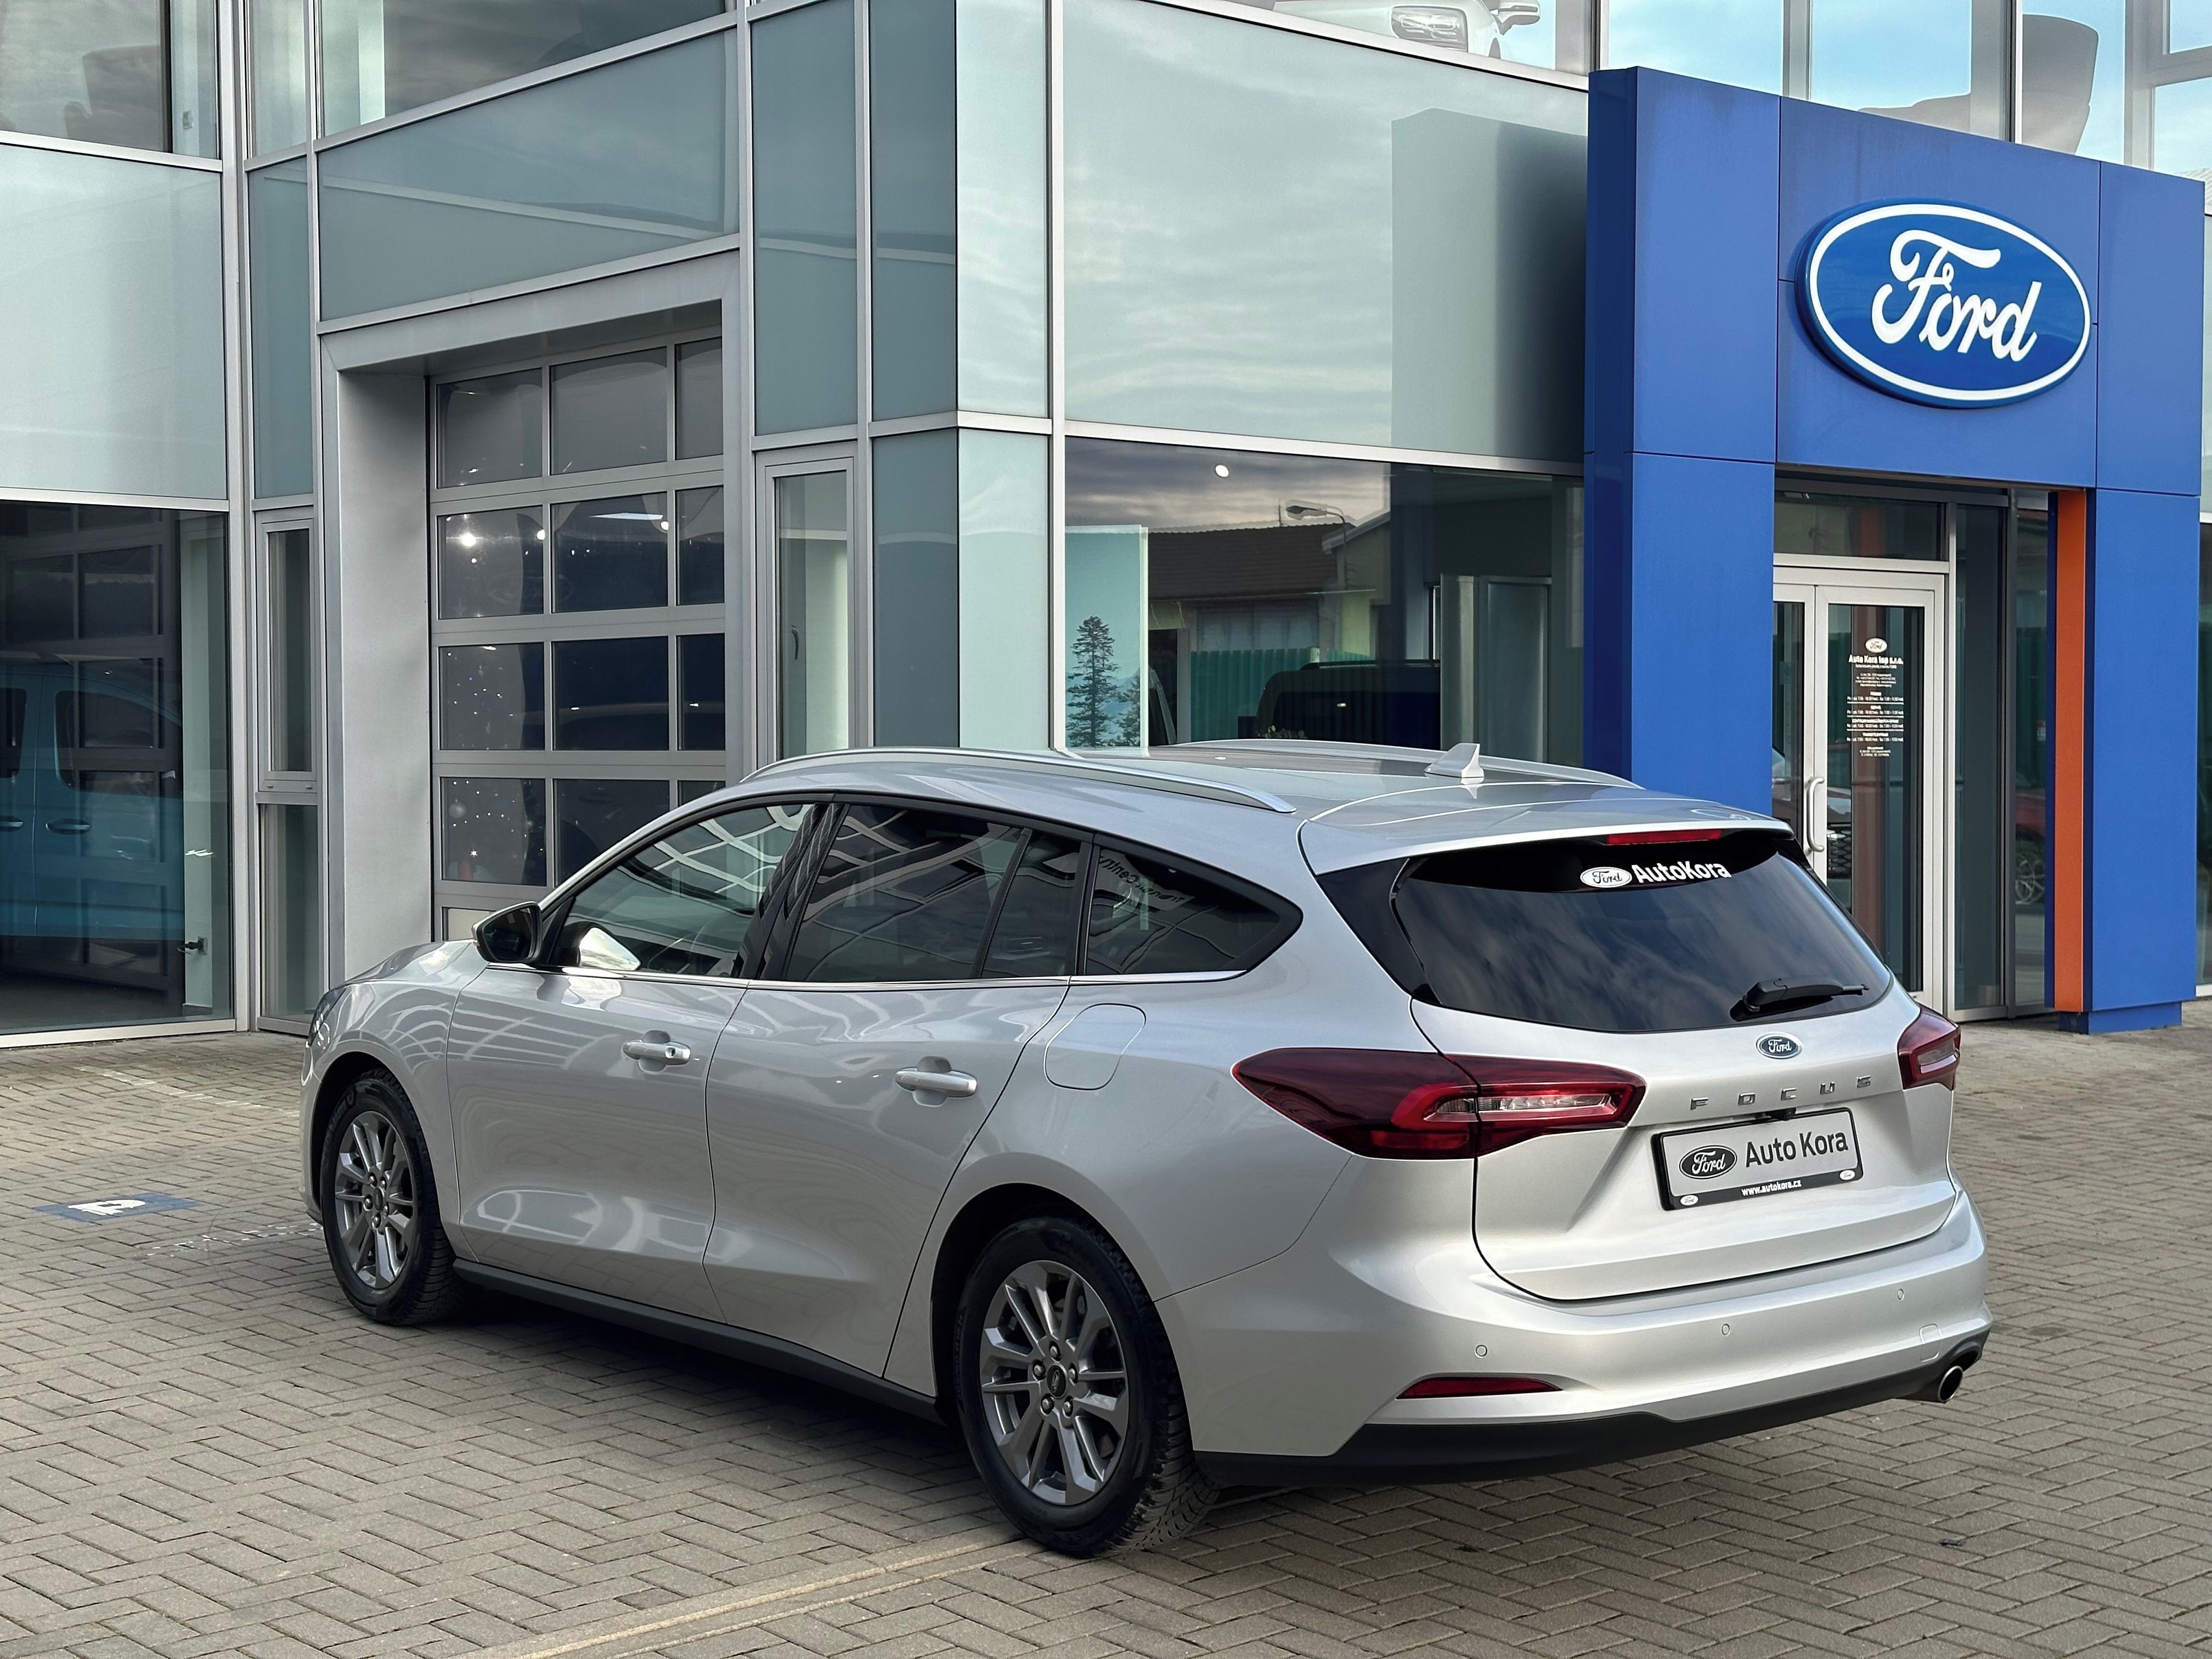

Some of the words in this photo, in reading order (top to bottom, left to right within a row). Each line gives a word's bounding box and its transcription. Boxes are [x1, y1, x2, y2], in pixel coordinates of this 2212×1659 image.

[1871, 229, 2042, 362] Ford
[1848, 654, 1864, 663] Auto
[1592, 871, 1623, 884] Ford
[1631, 861, 1732, 883] AutoKora
[1768, 1039, 1792, 1053] Ford
[1690, 1075, 1871, 1110] FOCUS
[1691, 1150, 1726, 1175] Ford
[1745, 1138, 1797, 1167] Auto
[1799, 1131, 1849, 1158] Kora
[1741, 1180, 1802, 1197] www.autokora.cz
